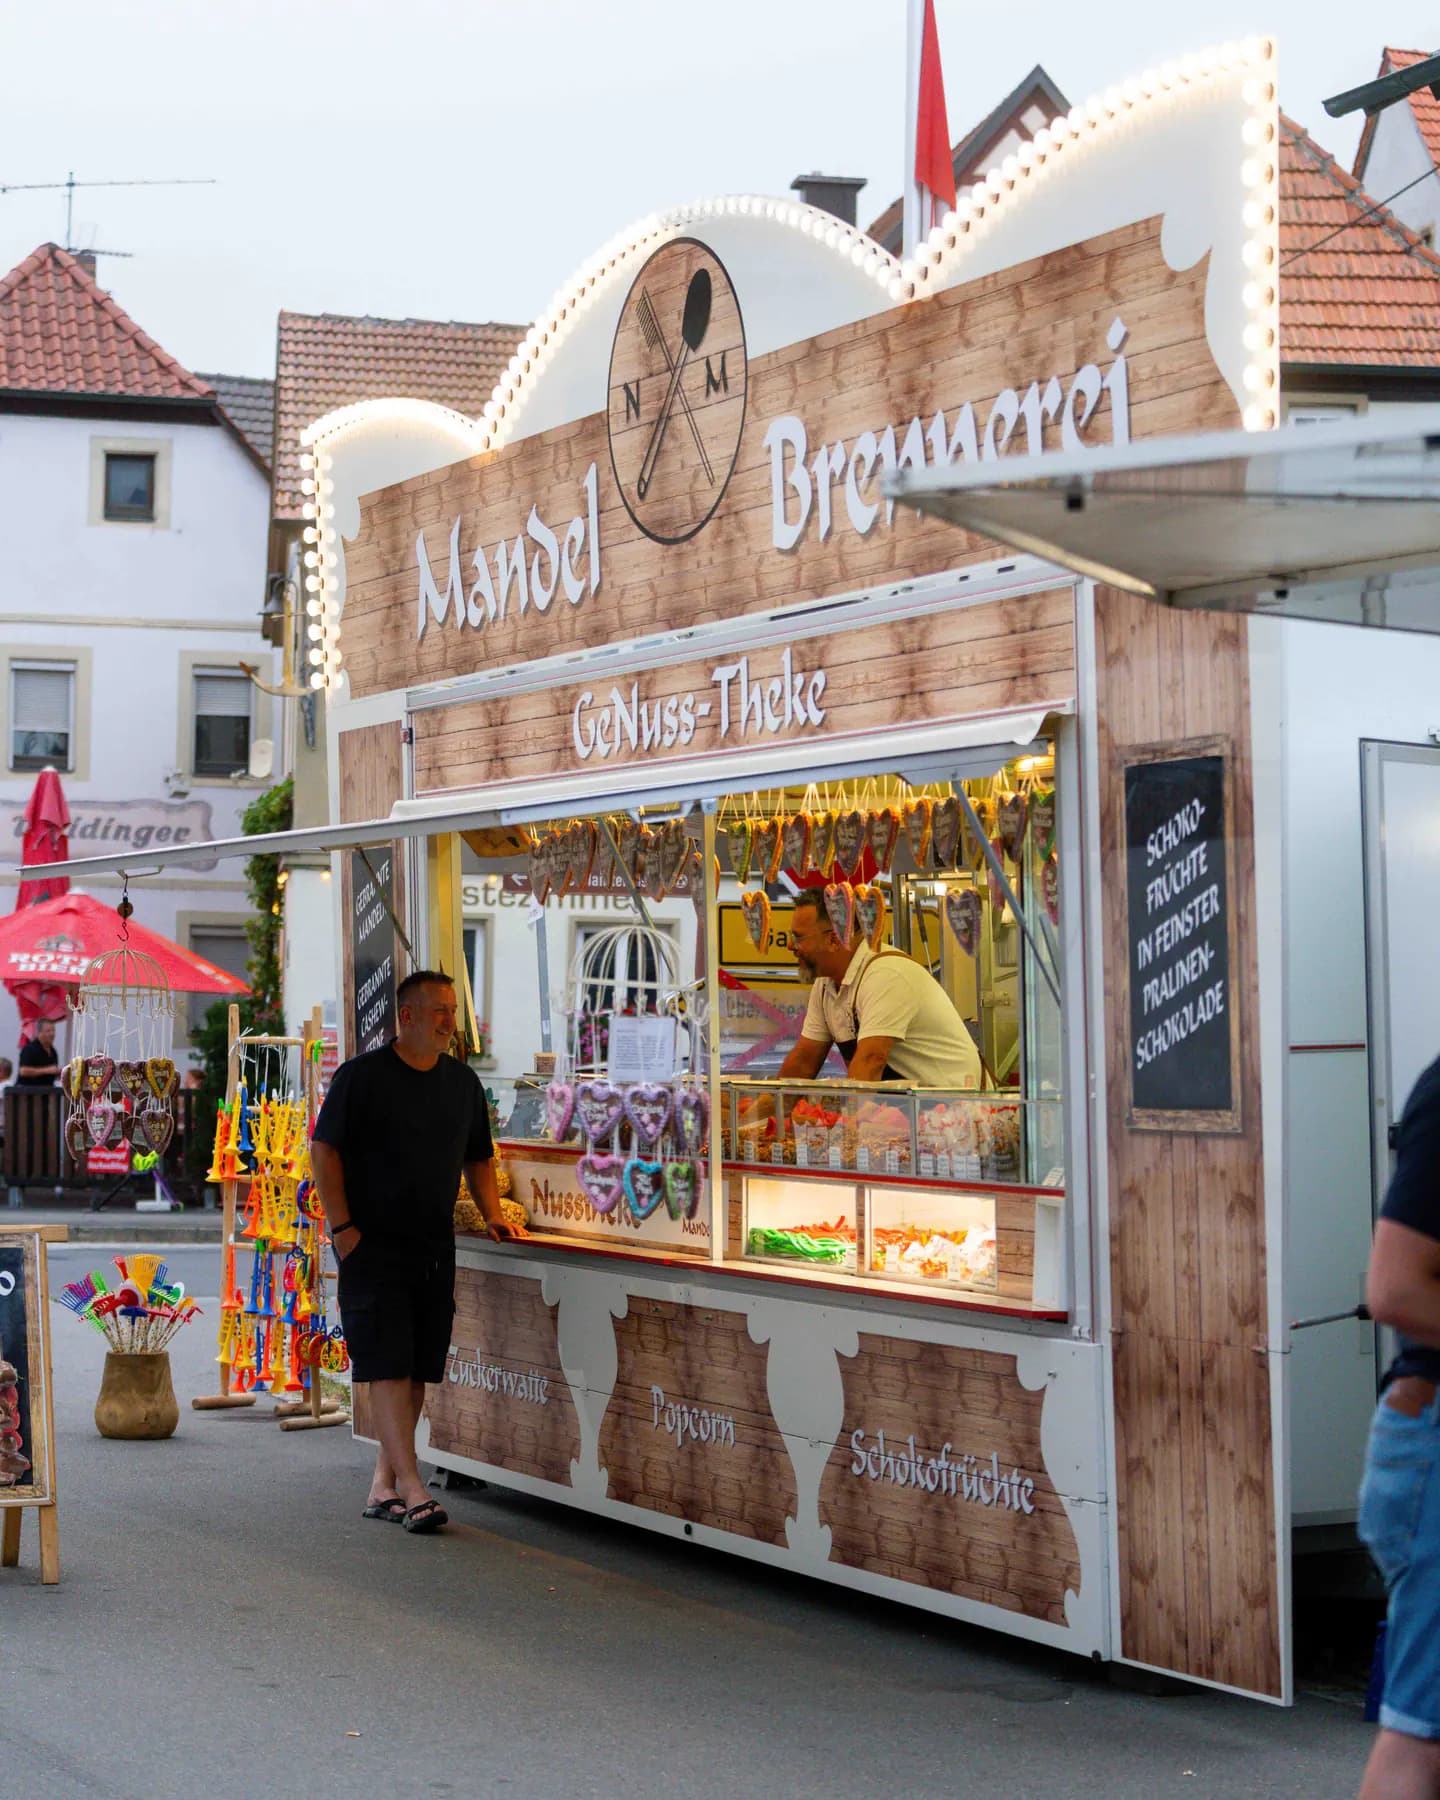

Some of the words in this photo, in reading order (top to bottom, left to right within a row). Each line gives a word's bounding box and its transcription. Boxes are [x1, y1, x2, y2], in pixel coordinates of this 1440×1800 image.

[623, 380, 641, 424] N
[705, 351, 730, 399] M
[762, 316, 1131, 551] Brennerei
[415, 461, 601, 641] Mandel
[573, 647, 827, 760] GeNuss-Theke
[1147, 797, 1206, 867] SCHOKO-
[355, 859, 391, 916] GEBRANTE
[1146, 840, 1209, 916] FRÜCHTE
[358, 901, 389, 945] MANDEL
[1138, 933, 1153, 972] IN
[1154, 883, 1220, 959] FEINSTER
[1143, 940, 1215, 1017] PRALINEN-
[1136, 979, 1225, 1071] SCHOKOLADE
[650, 1384, 736, 1449] Popcorn
[851, 1428, 1037, 1515] Schokofrüchte
